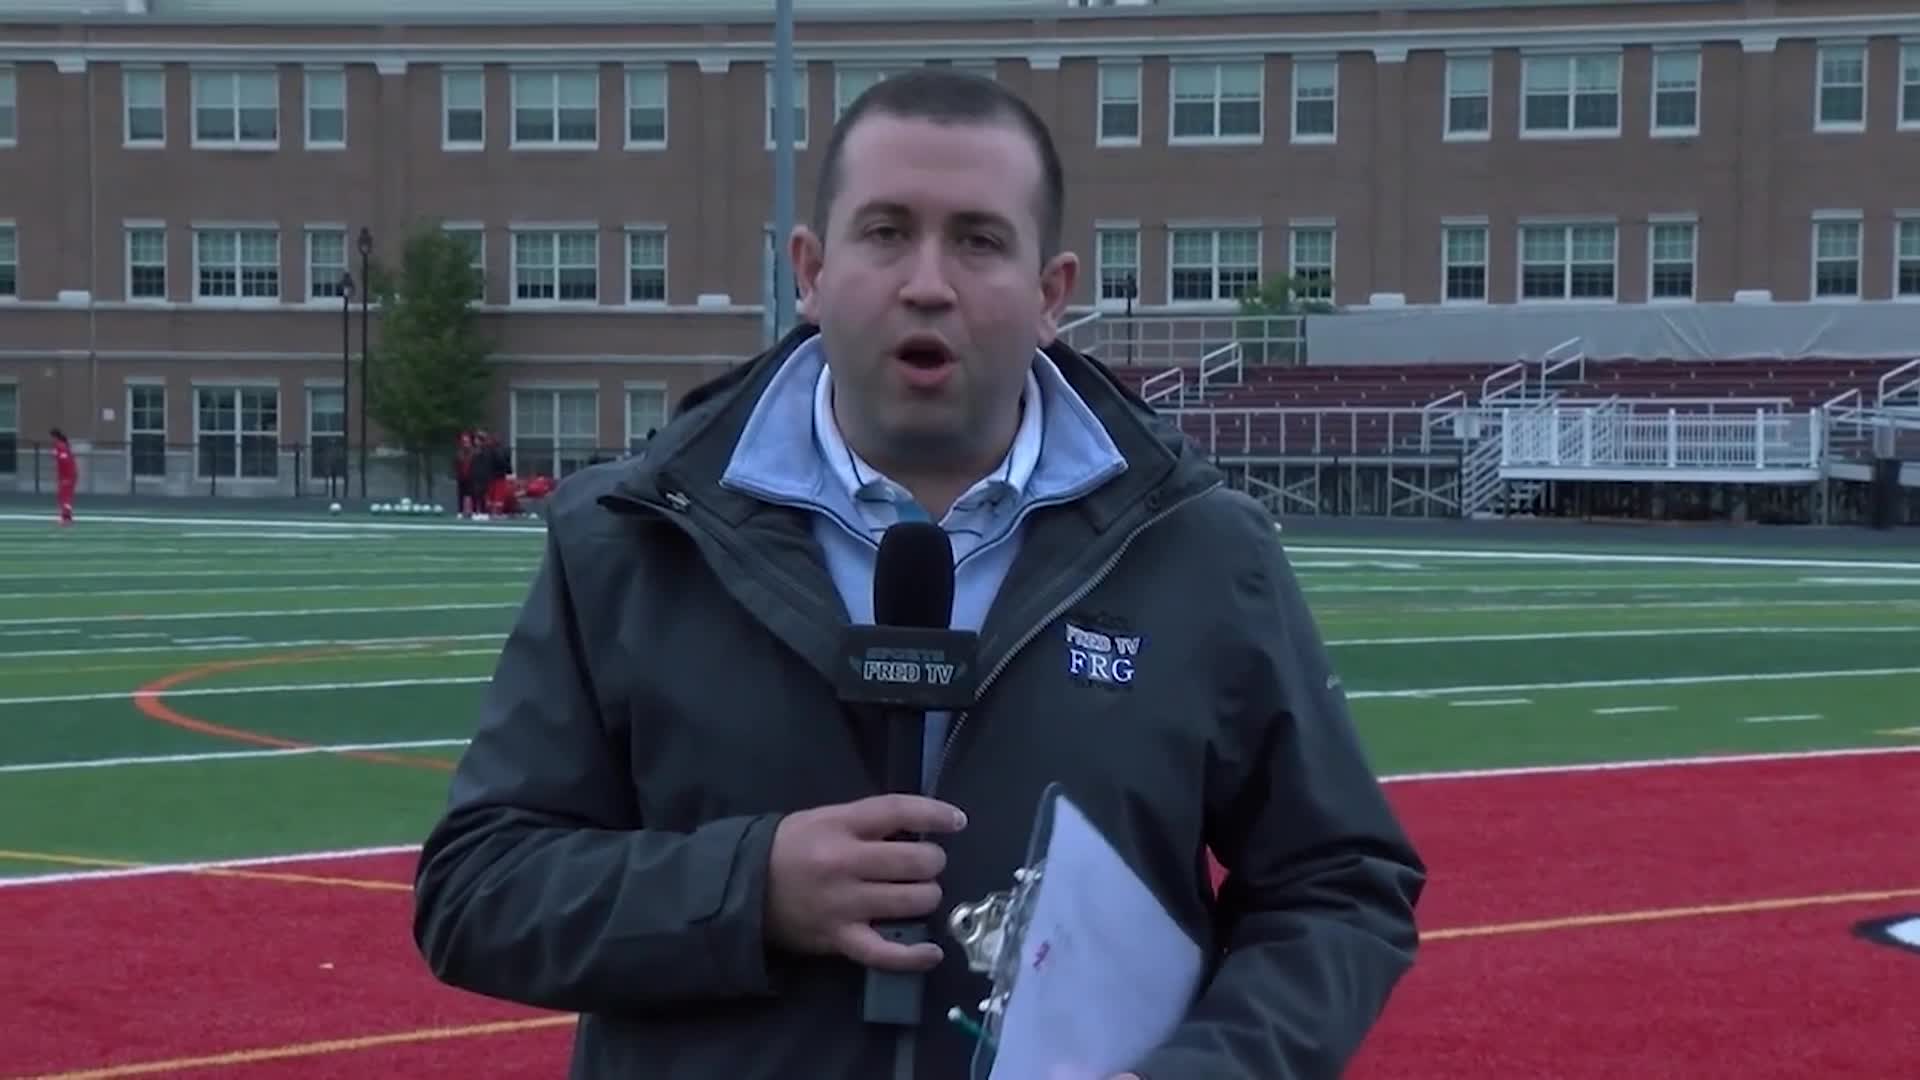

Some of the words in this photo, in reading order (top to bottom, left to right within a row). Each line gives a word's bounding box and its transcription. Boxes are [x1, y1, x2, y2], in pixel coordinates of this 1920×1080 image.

[863, 660, 921, 683] FRED
[925, 663, 954, 685] TV
[1069, 648, 1135, 682] FRG
